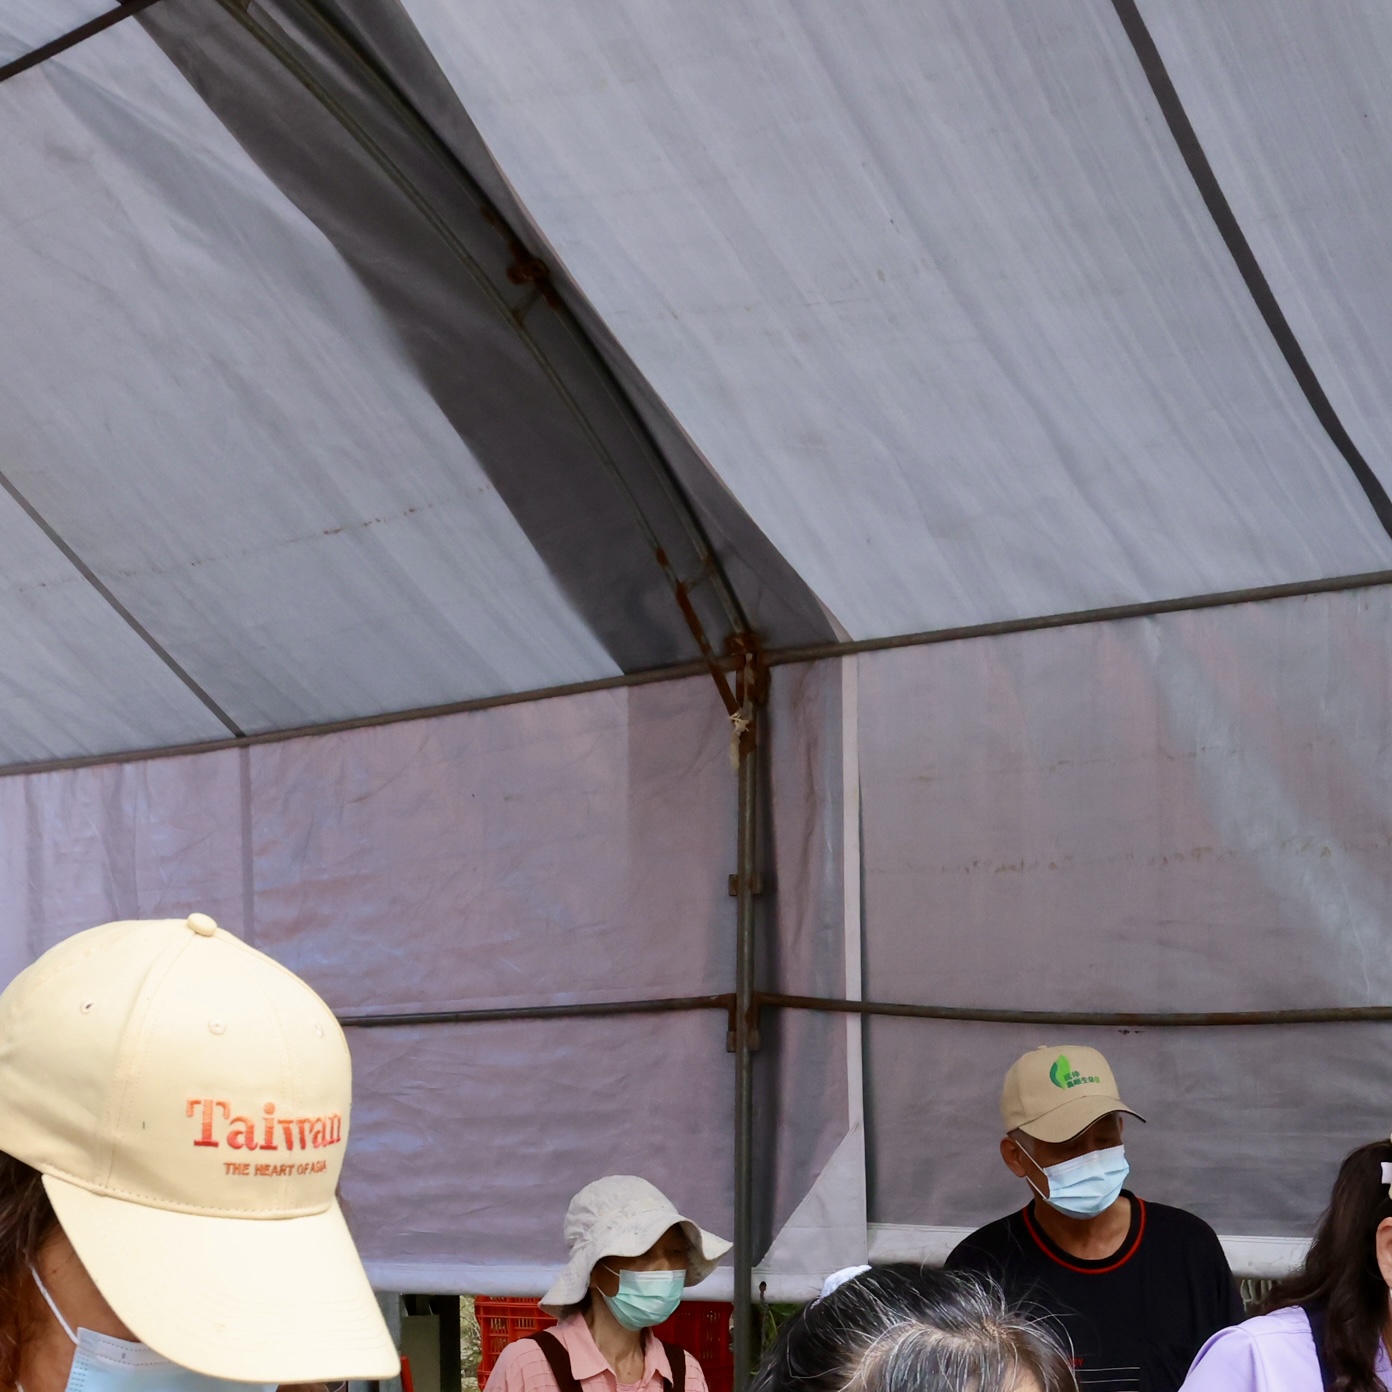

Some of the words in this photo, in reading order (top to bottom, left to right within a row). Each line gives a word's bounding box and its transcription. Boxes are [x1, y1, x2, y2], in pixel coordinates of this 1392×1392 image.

[185, 1098, 343, 1151] Taiwan
[224, 1162, 250, 1175] THE
[254, 1162, 296, 1177] HEART
